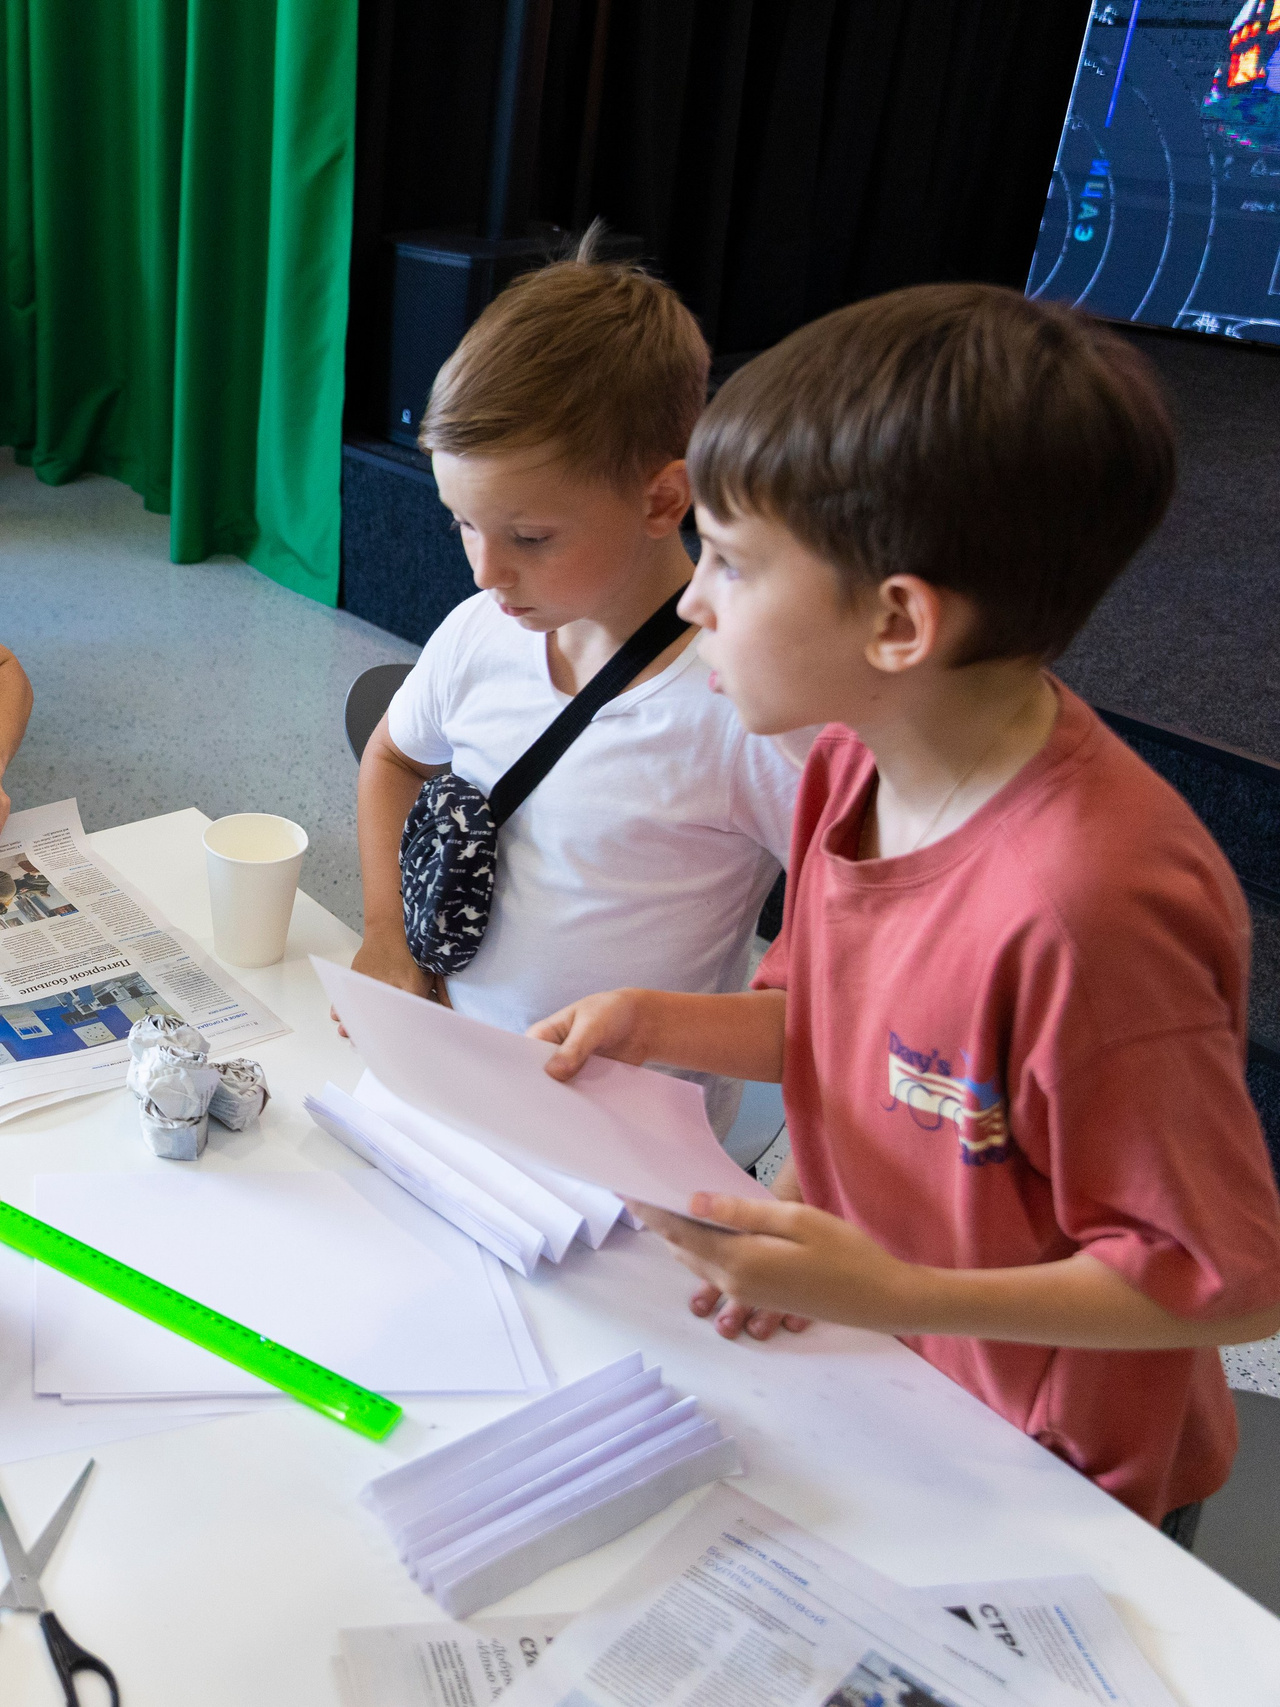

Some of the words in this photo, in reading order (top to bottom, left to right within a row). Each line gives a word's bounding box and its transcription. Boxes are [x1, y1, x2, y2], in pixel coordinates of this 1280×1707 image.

[69, 958, 131, 985] Пятеркой
[19, 973, 69, 997] больше
[197, 1019, 224, 1030] ГОРОДАХ
[229, 1012, 248, 1021] НОВОЕ
[706, 1545, 734, 1565] Без
[737, 1564, 828, 1625] платиновой
